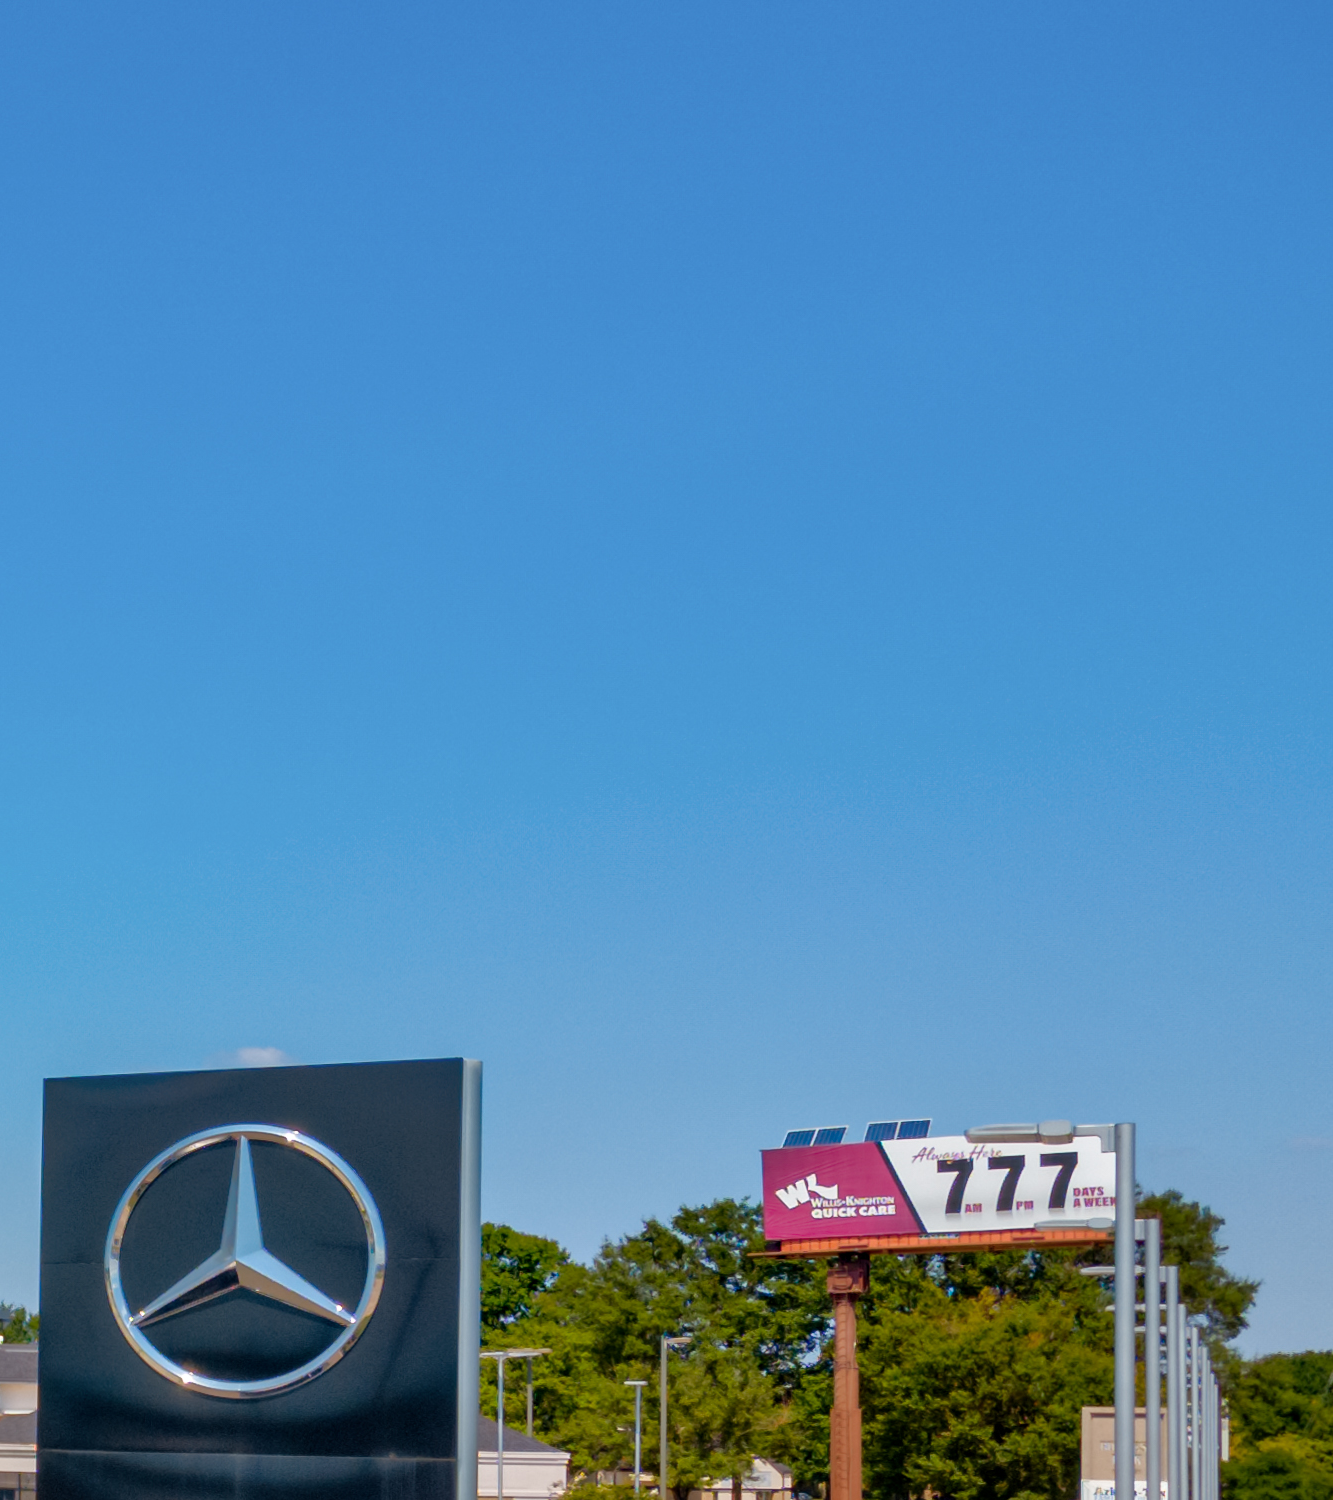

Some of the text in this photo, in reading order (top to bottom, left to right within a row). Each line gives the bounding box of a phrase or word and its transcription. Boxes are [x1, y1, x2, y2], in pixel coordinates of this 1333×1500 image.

[911, 1145, 1002, 1164] Always Here
[936, 1151, 1078, 1214] 7 AM 7 PM 7
[1073, 1186, 1104, 1197] DAYS
[1073, 1198, 1082, 1208] A
[811, 1205, 896, 1219] QUICK CARE
